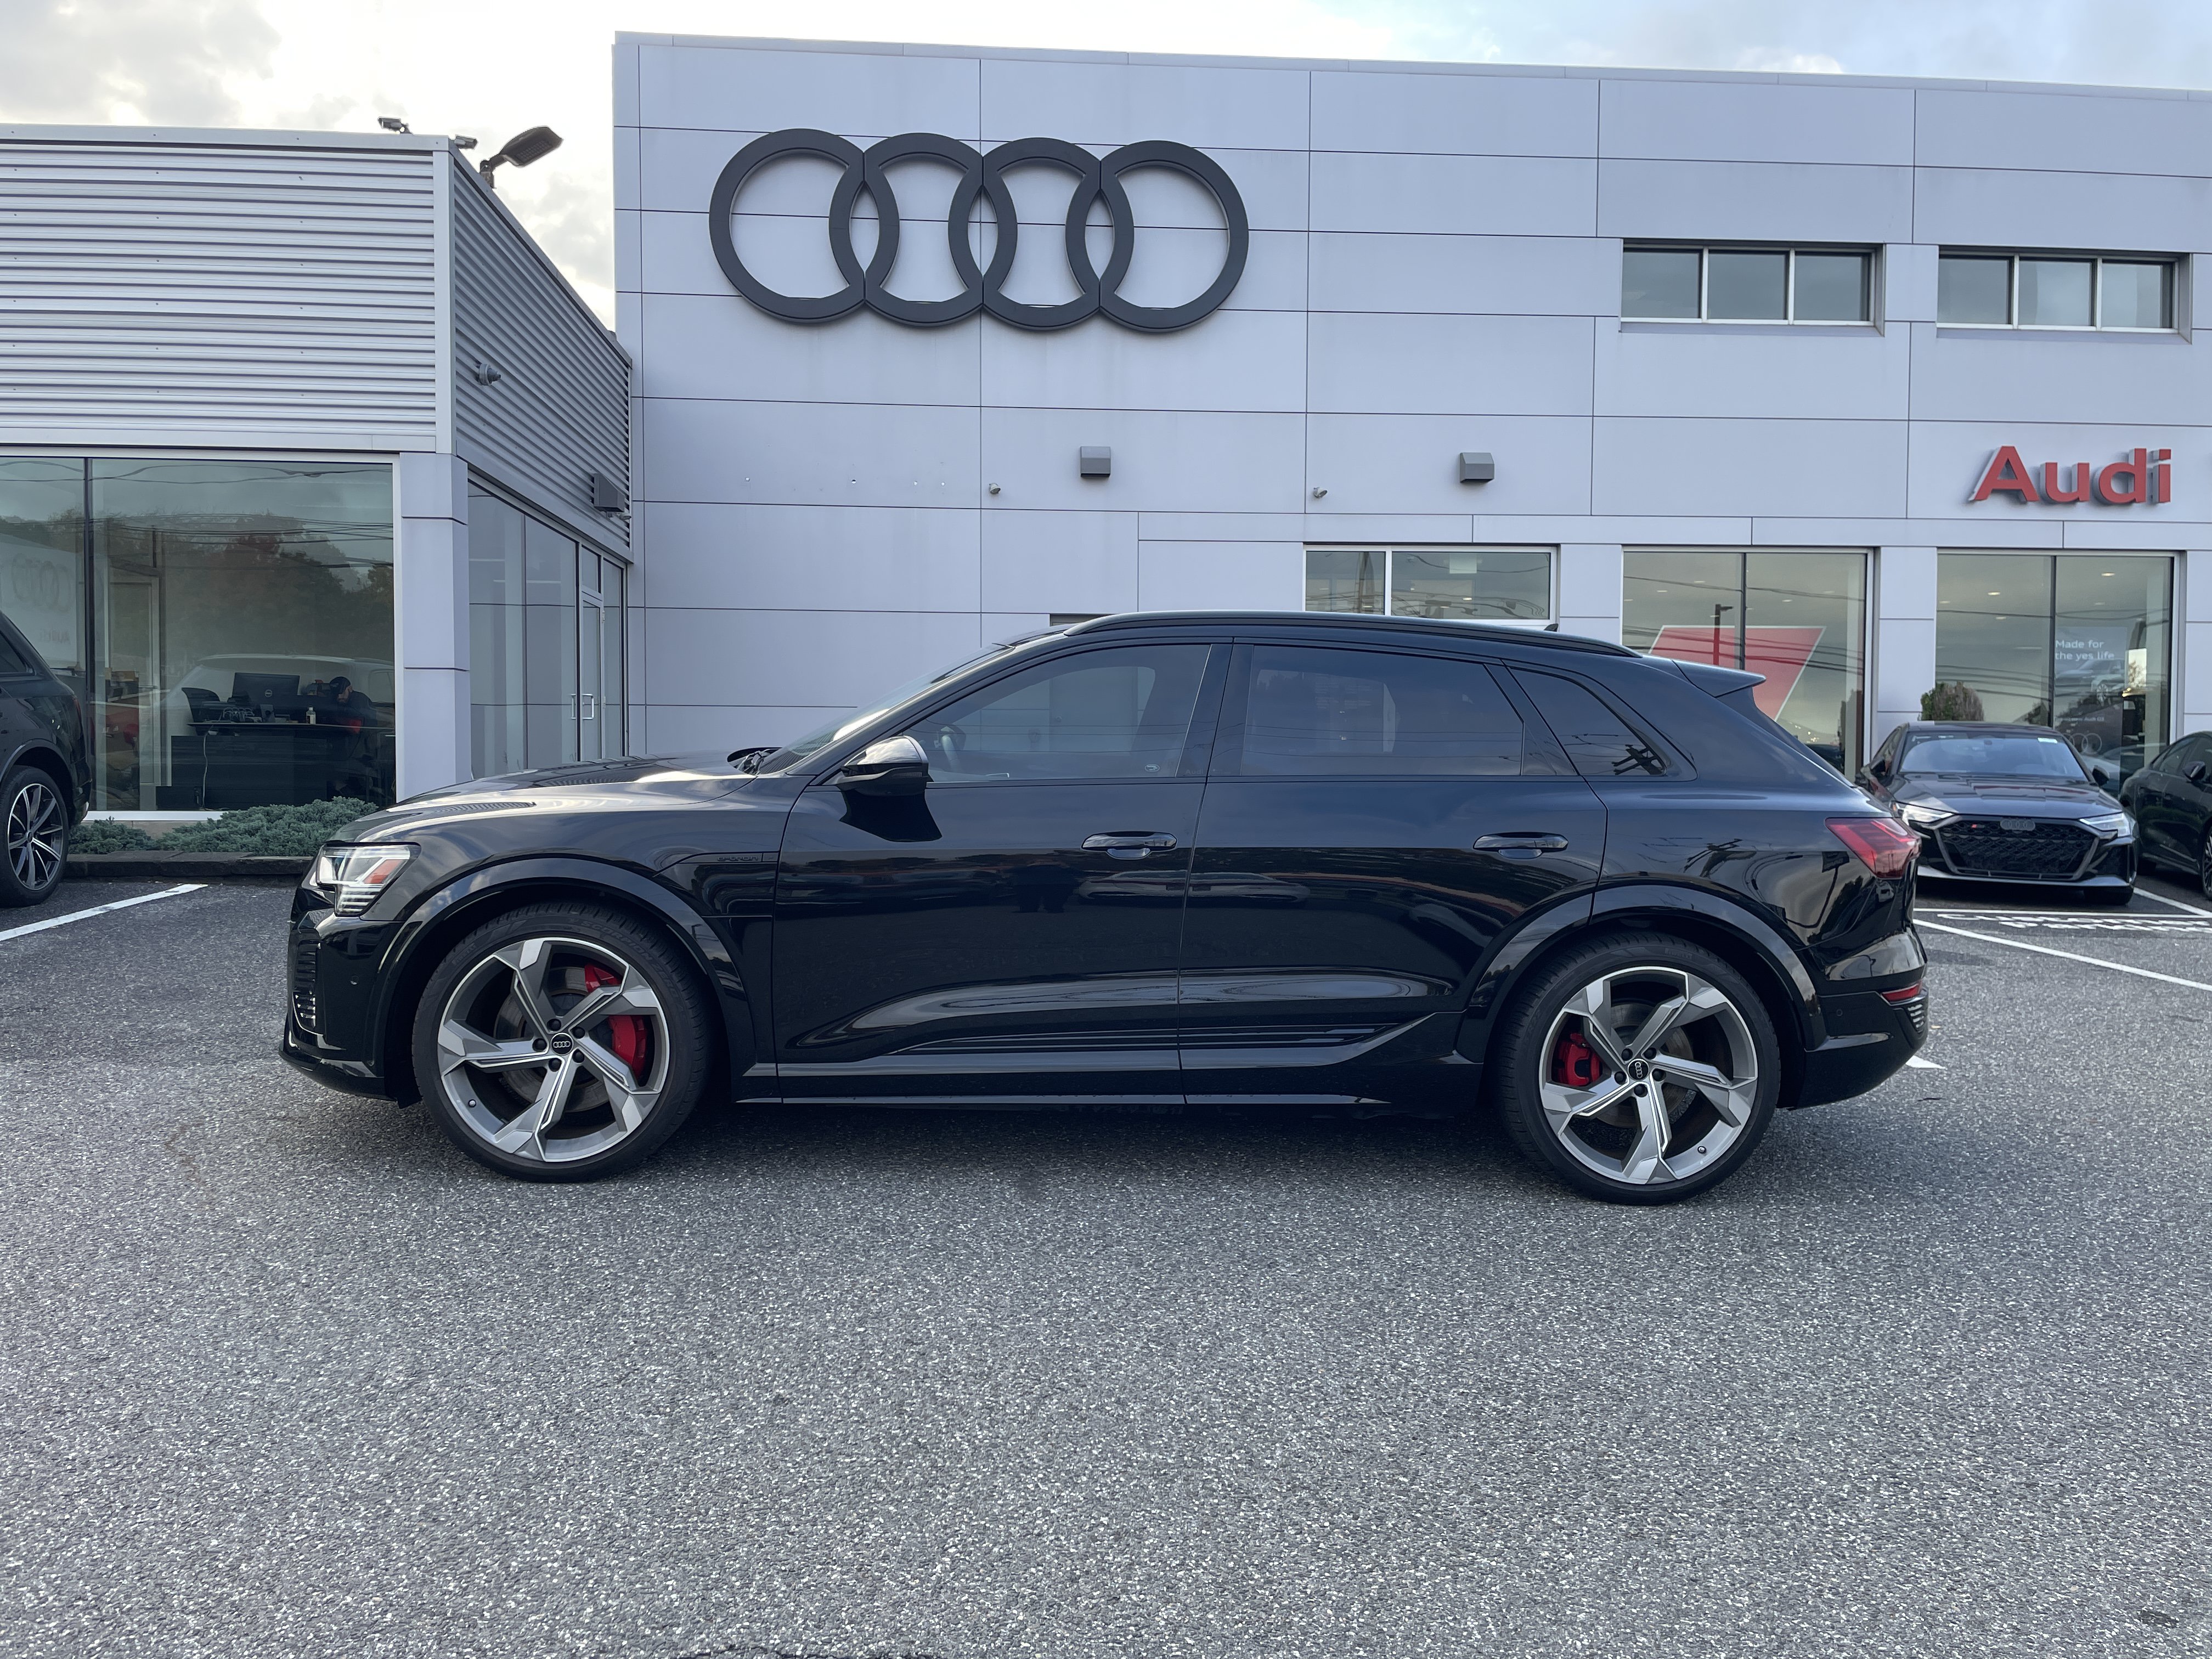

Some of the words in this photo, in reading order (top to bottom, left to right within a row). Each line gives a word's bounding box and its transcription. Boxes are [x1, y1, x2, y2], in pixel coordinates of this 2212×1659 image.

[1972, 445, 2172, 504] Audi
[2055, 639, 2085, 649] Made
[2088, 639, 2104, 648] for
[2055, 651, 2073, 661] the
[2075, 653, 2094, 662] yes
[2097, 651, 2115, 661] life
[580, 920, 653, 961] SCORPION
